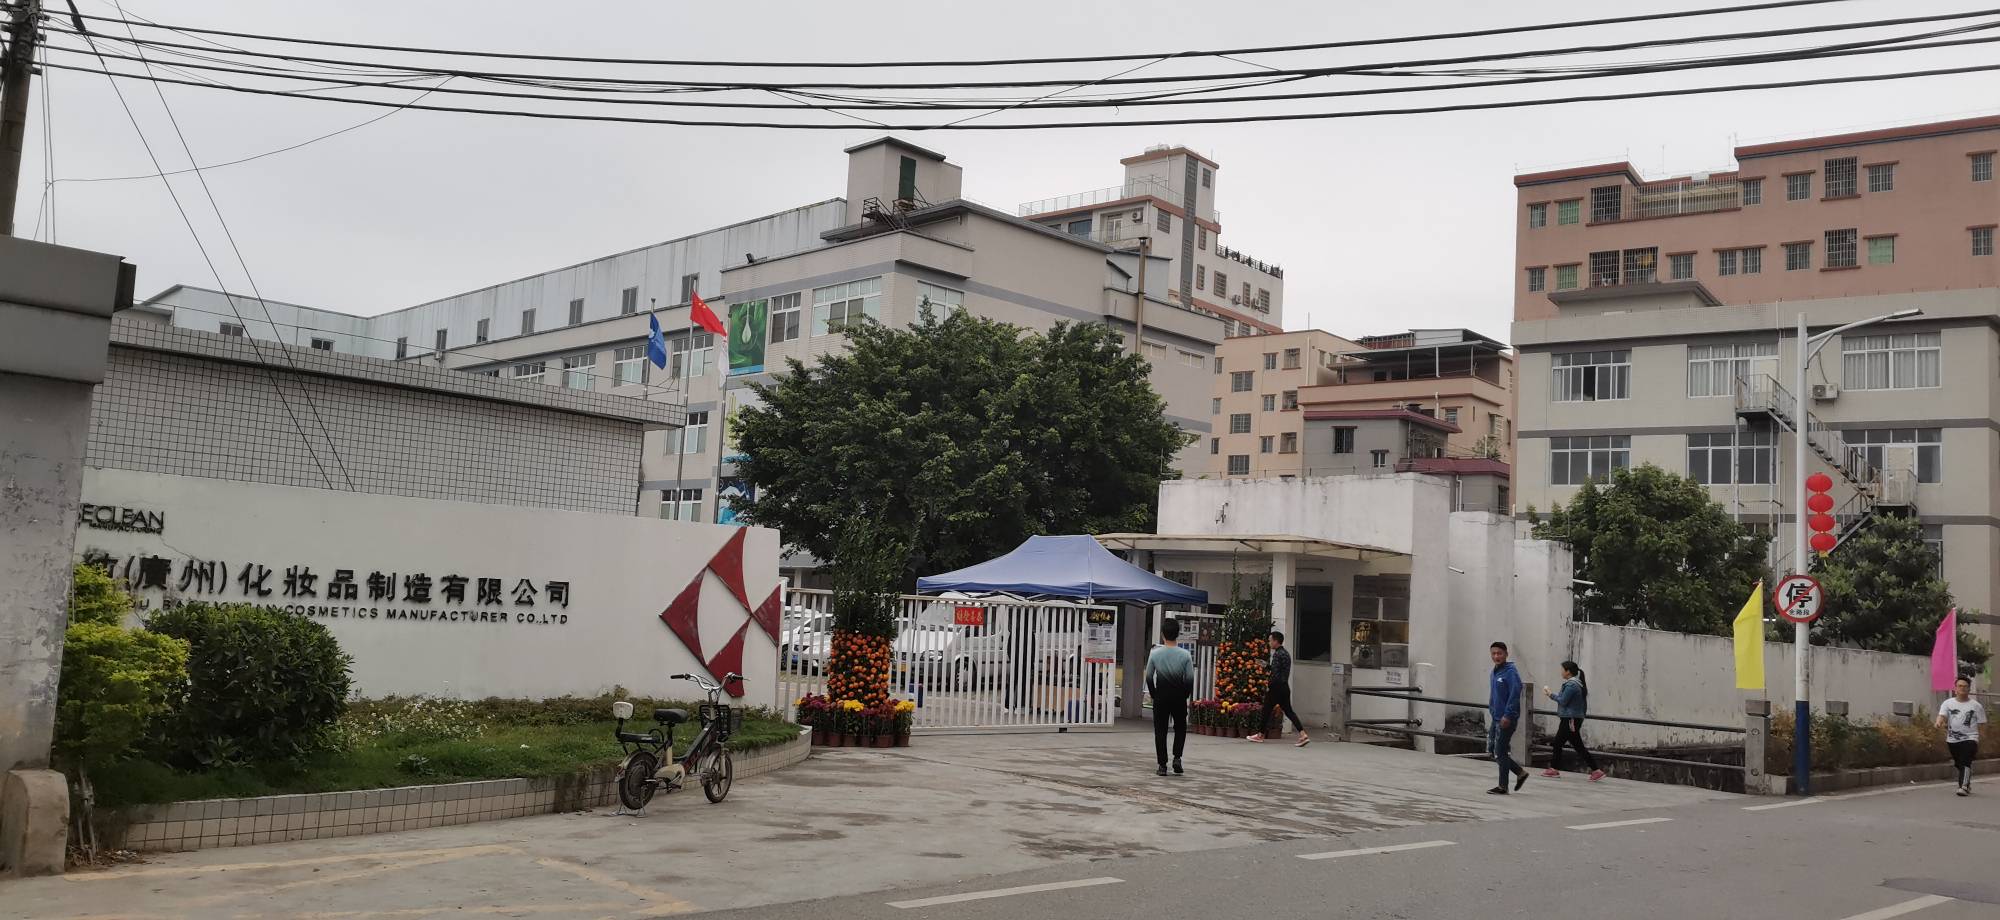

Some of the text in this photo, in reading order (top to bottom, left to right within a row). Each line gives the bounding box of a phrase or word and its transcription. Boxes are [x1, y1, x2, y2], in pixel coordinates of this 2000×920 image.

[79, 503, 164, 530] ECLEAN
[1786, 583, 1812, 608] 停
[285, 603, 379, 619] COSMETICS
[386, 609, 508, 623] MANUFACTURER
